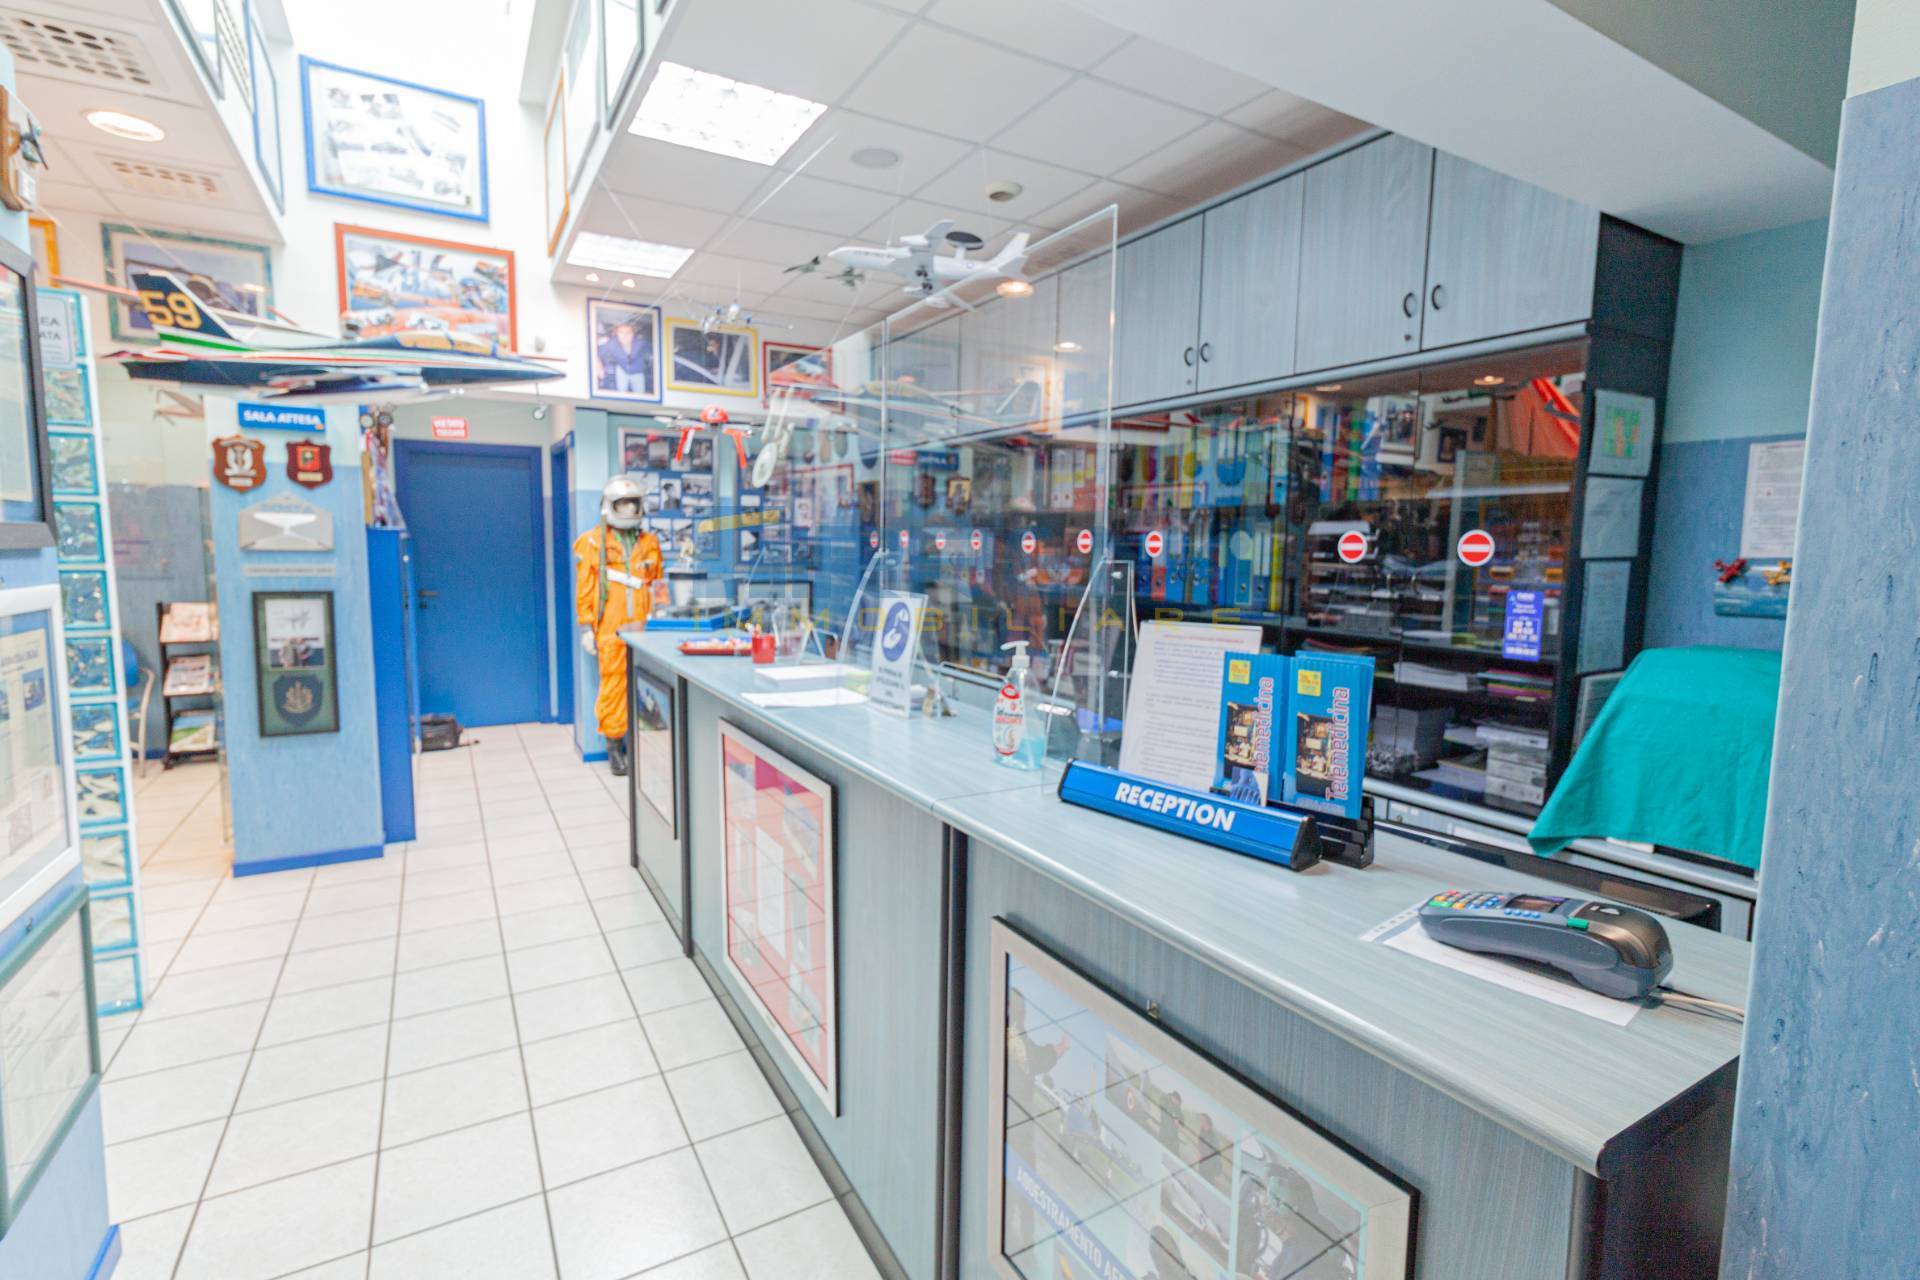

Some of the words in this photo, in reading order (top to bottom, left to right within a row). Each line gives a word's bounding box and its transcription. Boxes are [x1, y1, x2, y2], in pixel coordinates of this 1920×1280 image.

[138, 290, 202, 329] 59
[243, 409, 277, 424] SALA
[277, 412, 322, 426] ATTESA
[1325, 686, 1351, 801] Telemedicina
[1114, 781, 1236, 832] RECEPTION
